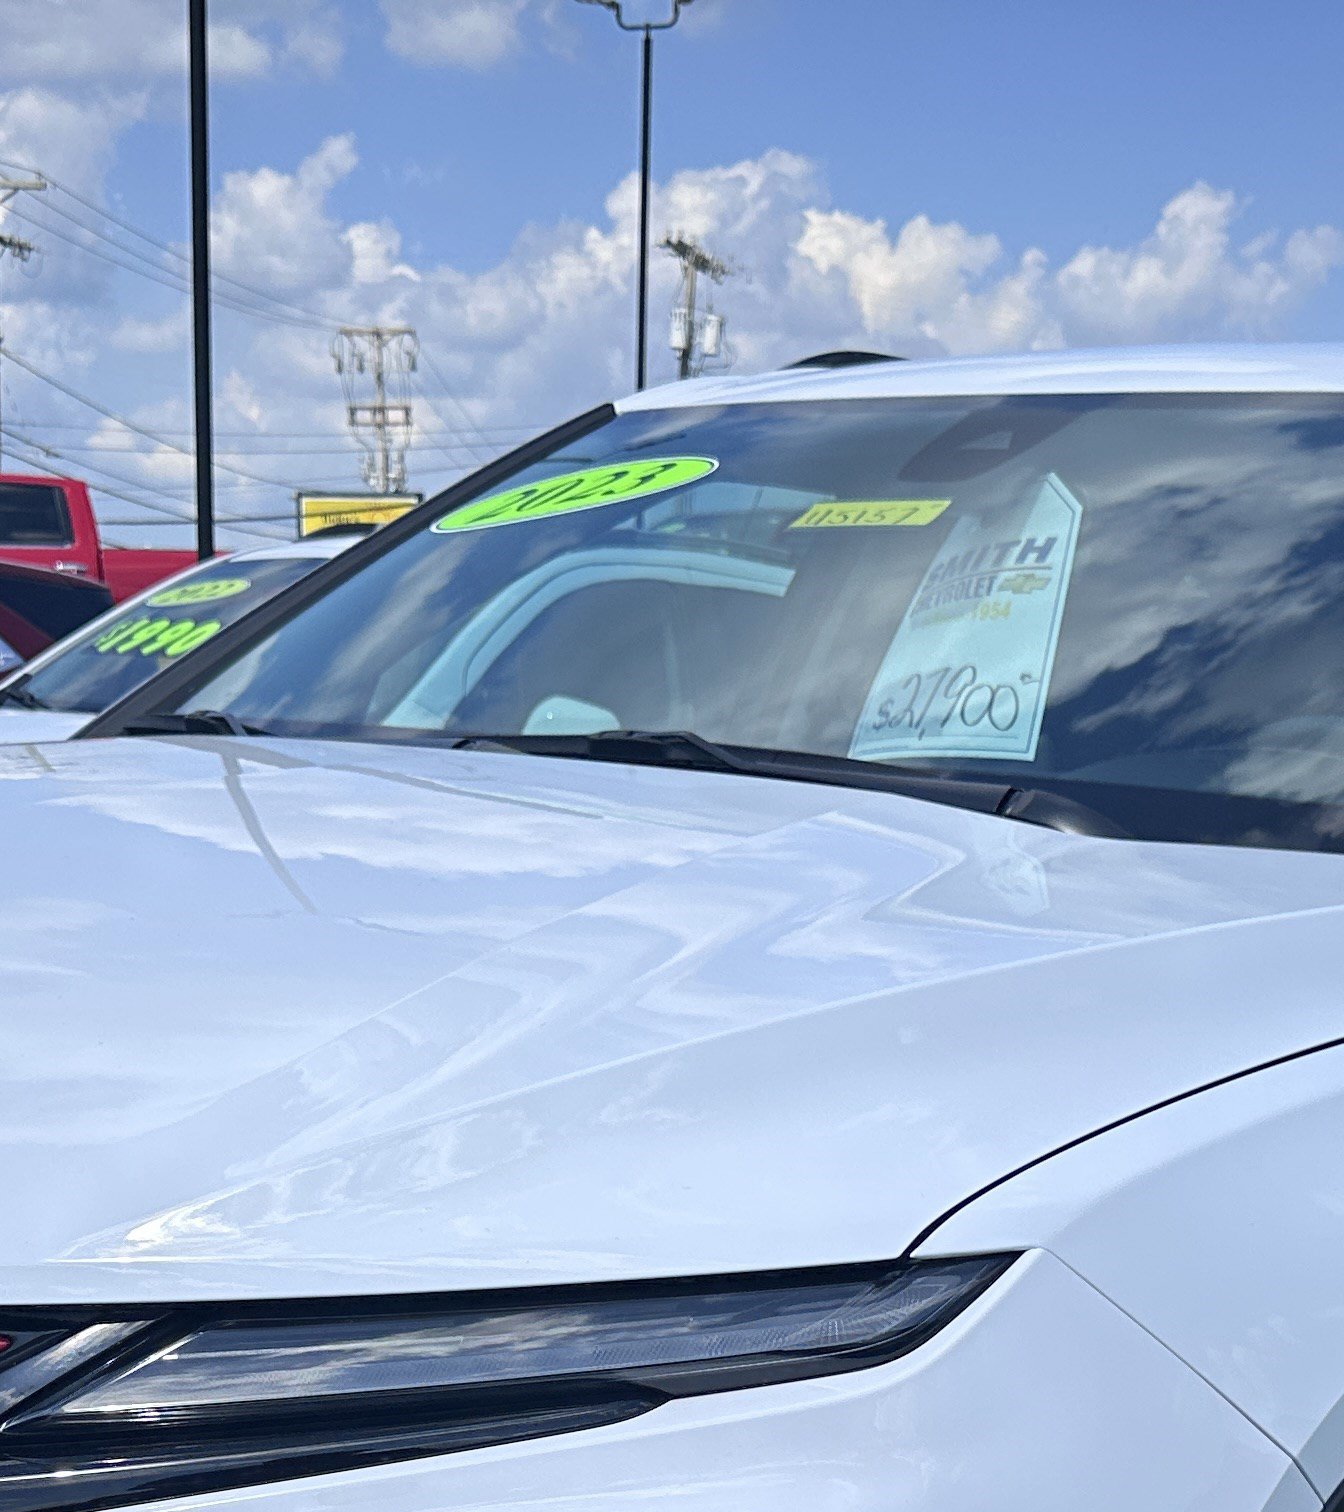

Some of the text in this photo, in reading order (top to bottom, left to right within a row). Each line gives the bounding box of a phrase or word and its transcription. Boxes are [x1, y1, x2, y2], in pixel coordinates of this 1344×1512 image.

[466, 463, 678, 525] 2023
[926, 537, 1058, 584] SMITH
[873, 664, 1020, 741] $27,900
